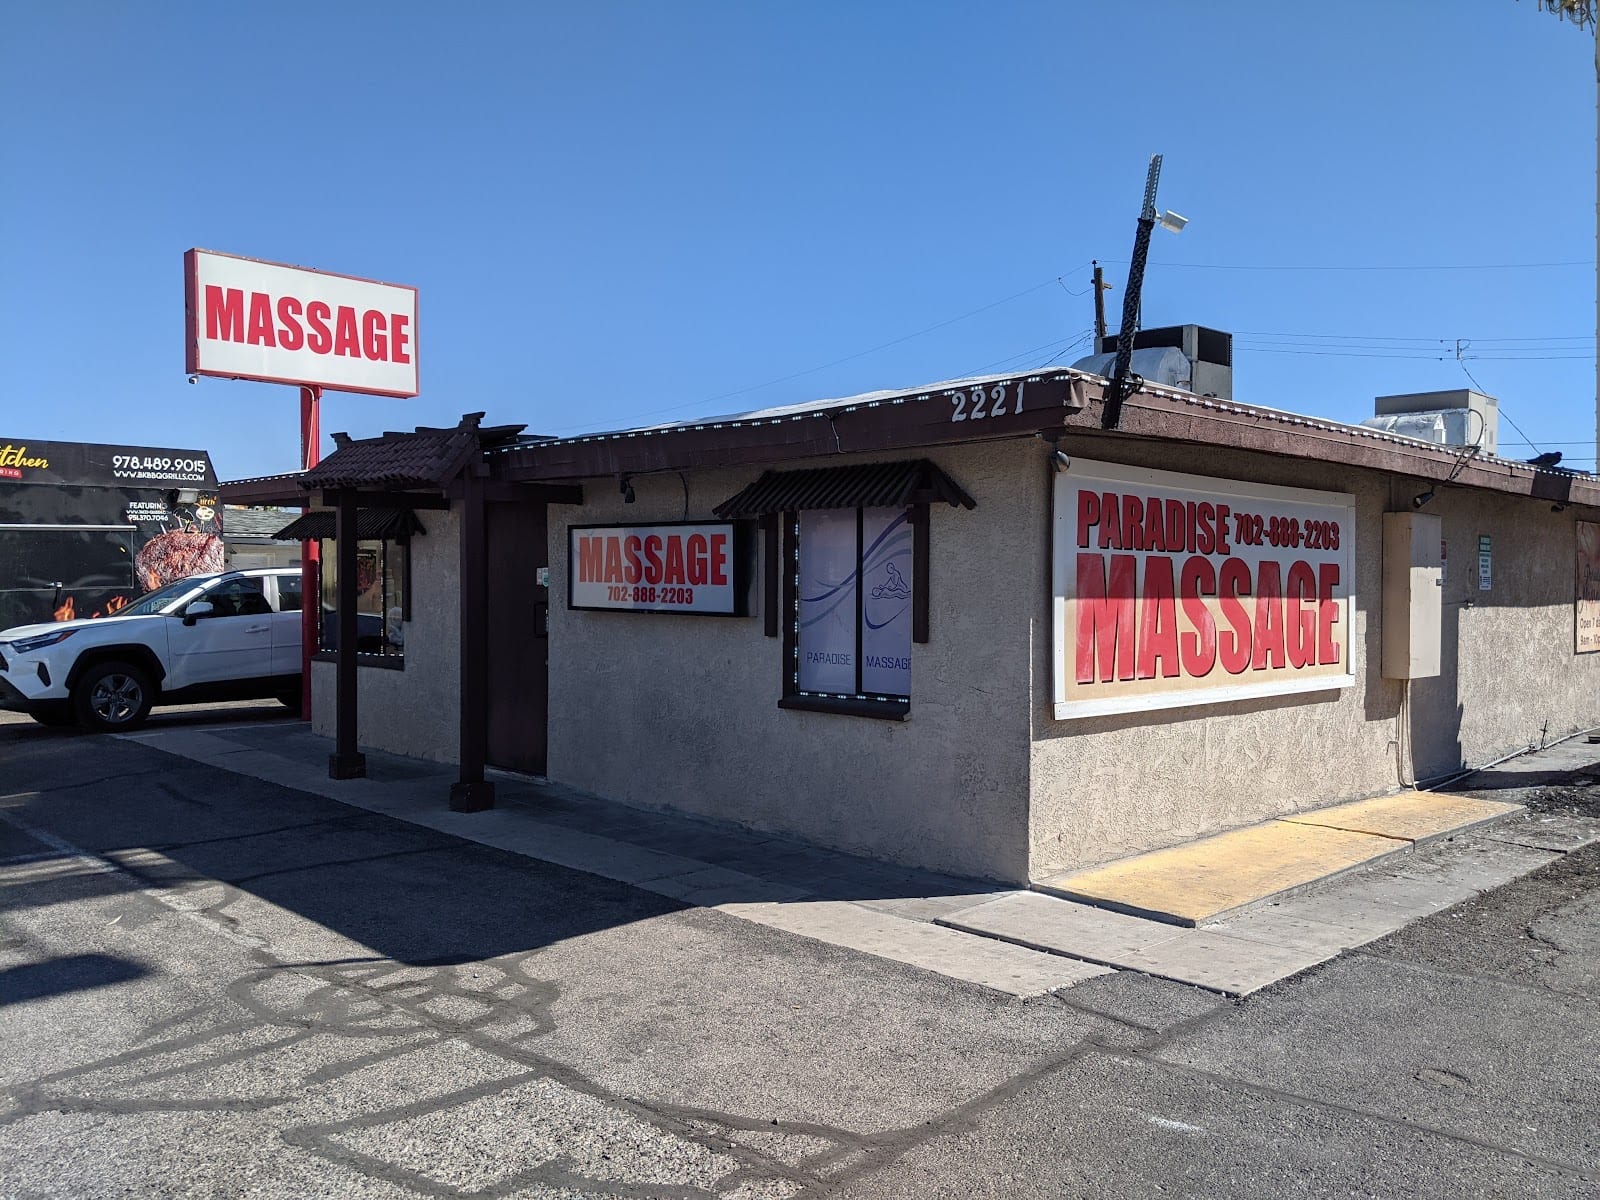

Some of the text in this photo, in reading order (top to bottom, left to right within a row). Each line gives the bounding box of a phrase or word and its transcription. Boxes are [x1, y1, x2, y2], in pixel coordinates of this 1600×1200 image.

[205, 284, 410, 364] MASSAGE
[951, 381, 1024, 423] 2221
[0, 444, 49, 469] tchen
[112, 455, 206, 473] 978.489.9015
[1076, 489, 1341, 555] PARADISE 702-888-2203
[579, 533, 727, 586] MASSAGE
[607, 585, 694, 605] 702-888-2203
[1075, 552, 1341, 685] MASSAGE
[806, 651, 852, 666] PARADISE
